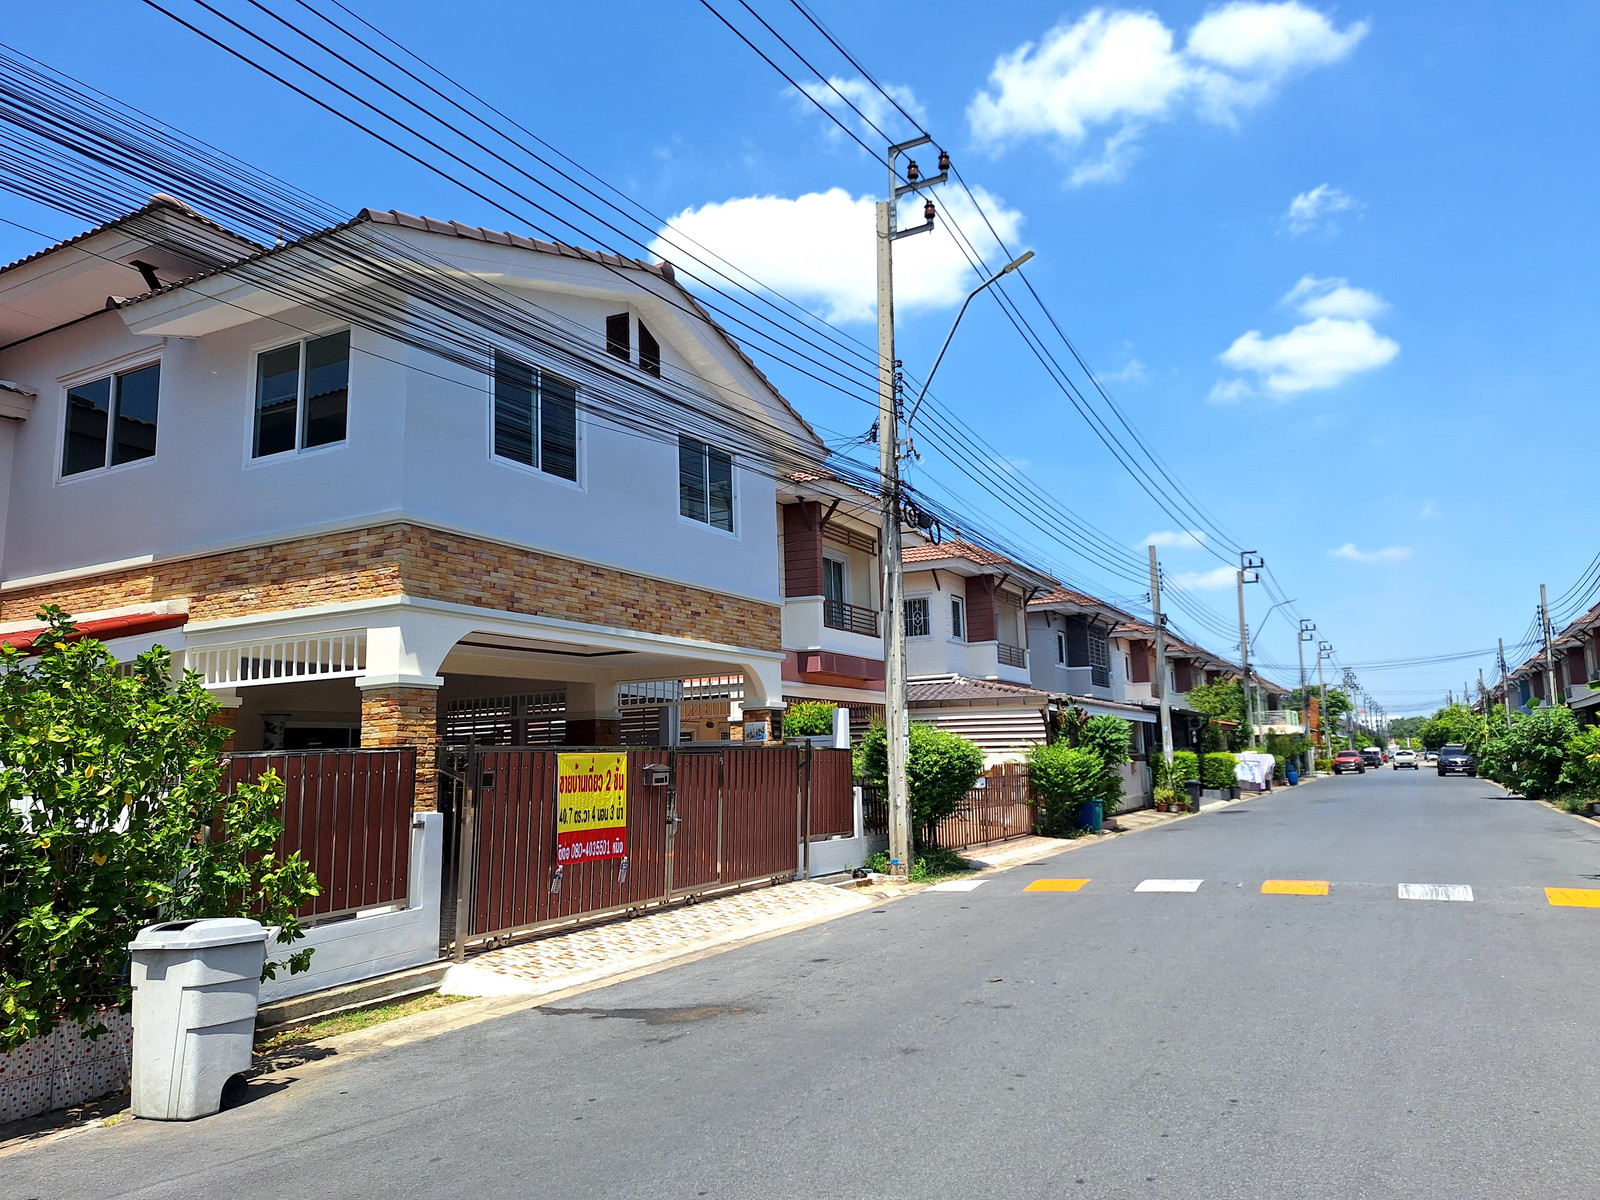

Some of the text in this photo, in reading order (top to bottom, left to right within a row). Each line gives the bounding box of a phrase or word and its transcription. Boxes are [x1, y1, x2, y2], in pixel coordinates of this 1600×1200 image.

[559, 757, 625, 794] ขายบ้านเดี่ยว 2 ชั้น
[559, 807, 574, 825] 40.7
[592, 805, 596, 823] 4
[597, 807, 609, 822] นอน
[610, 804, 615, 821] 3
